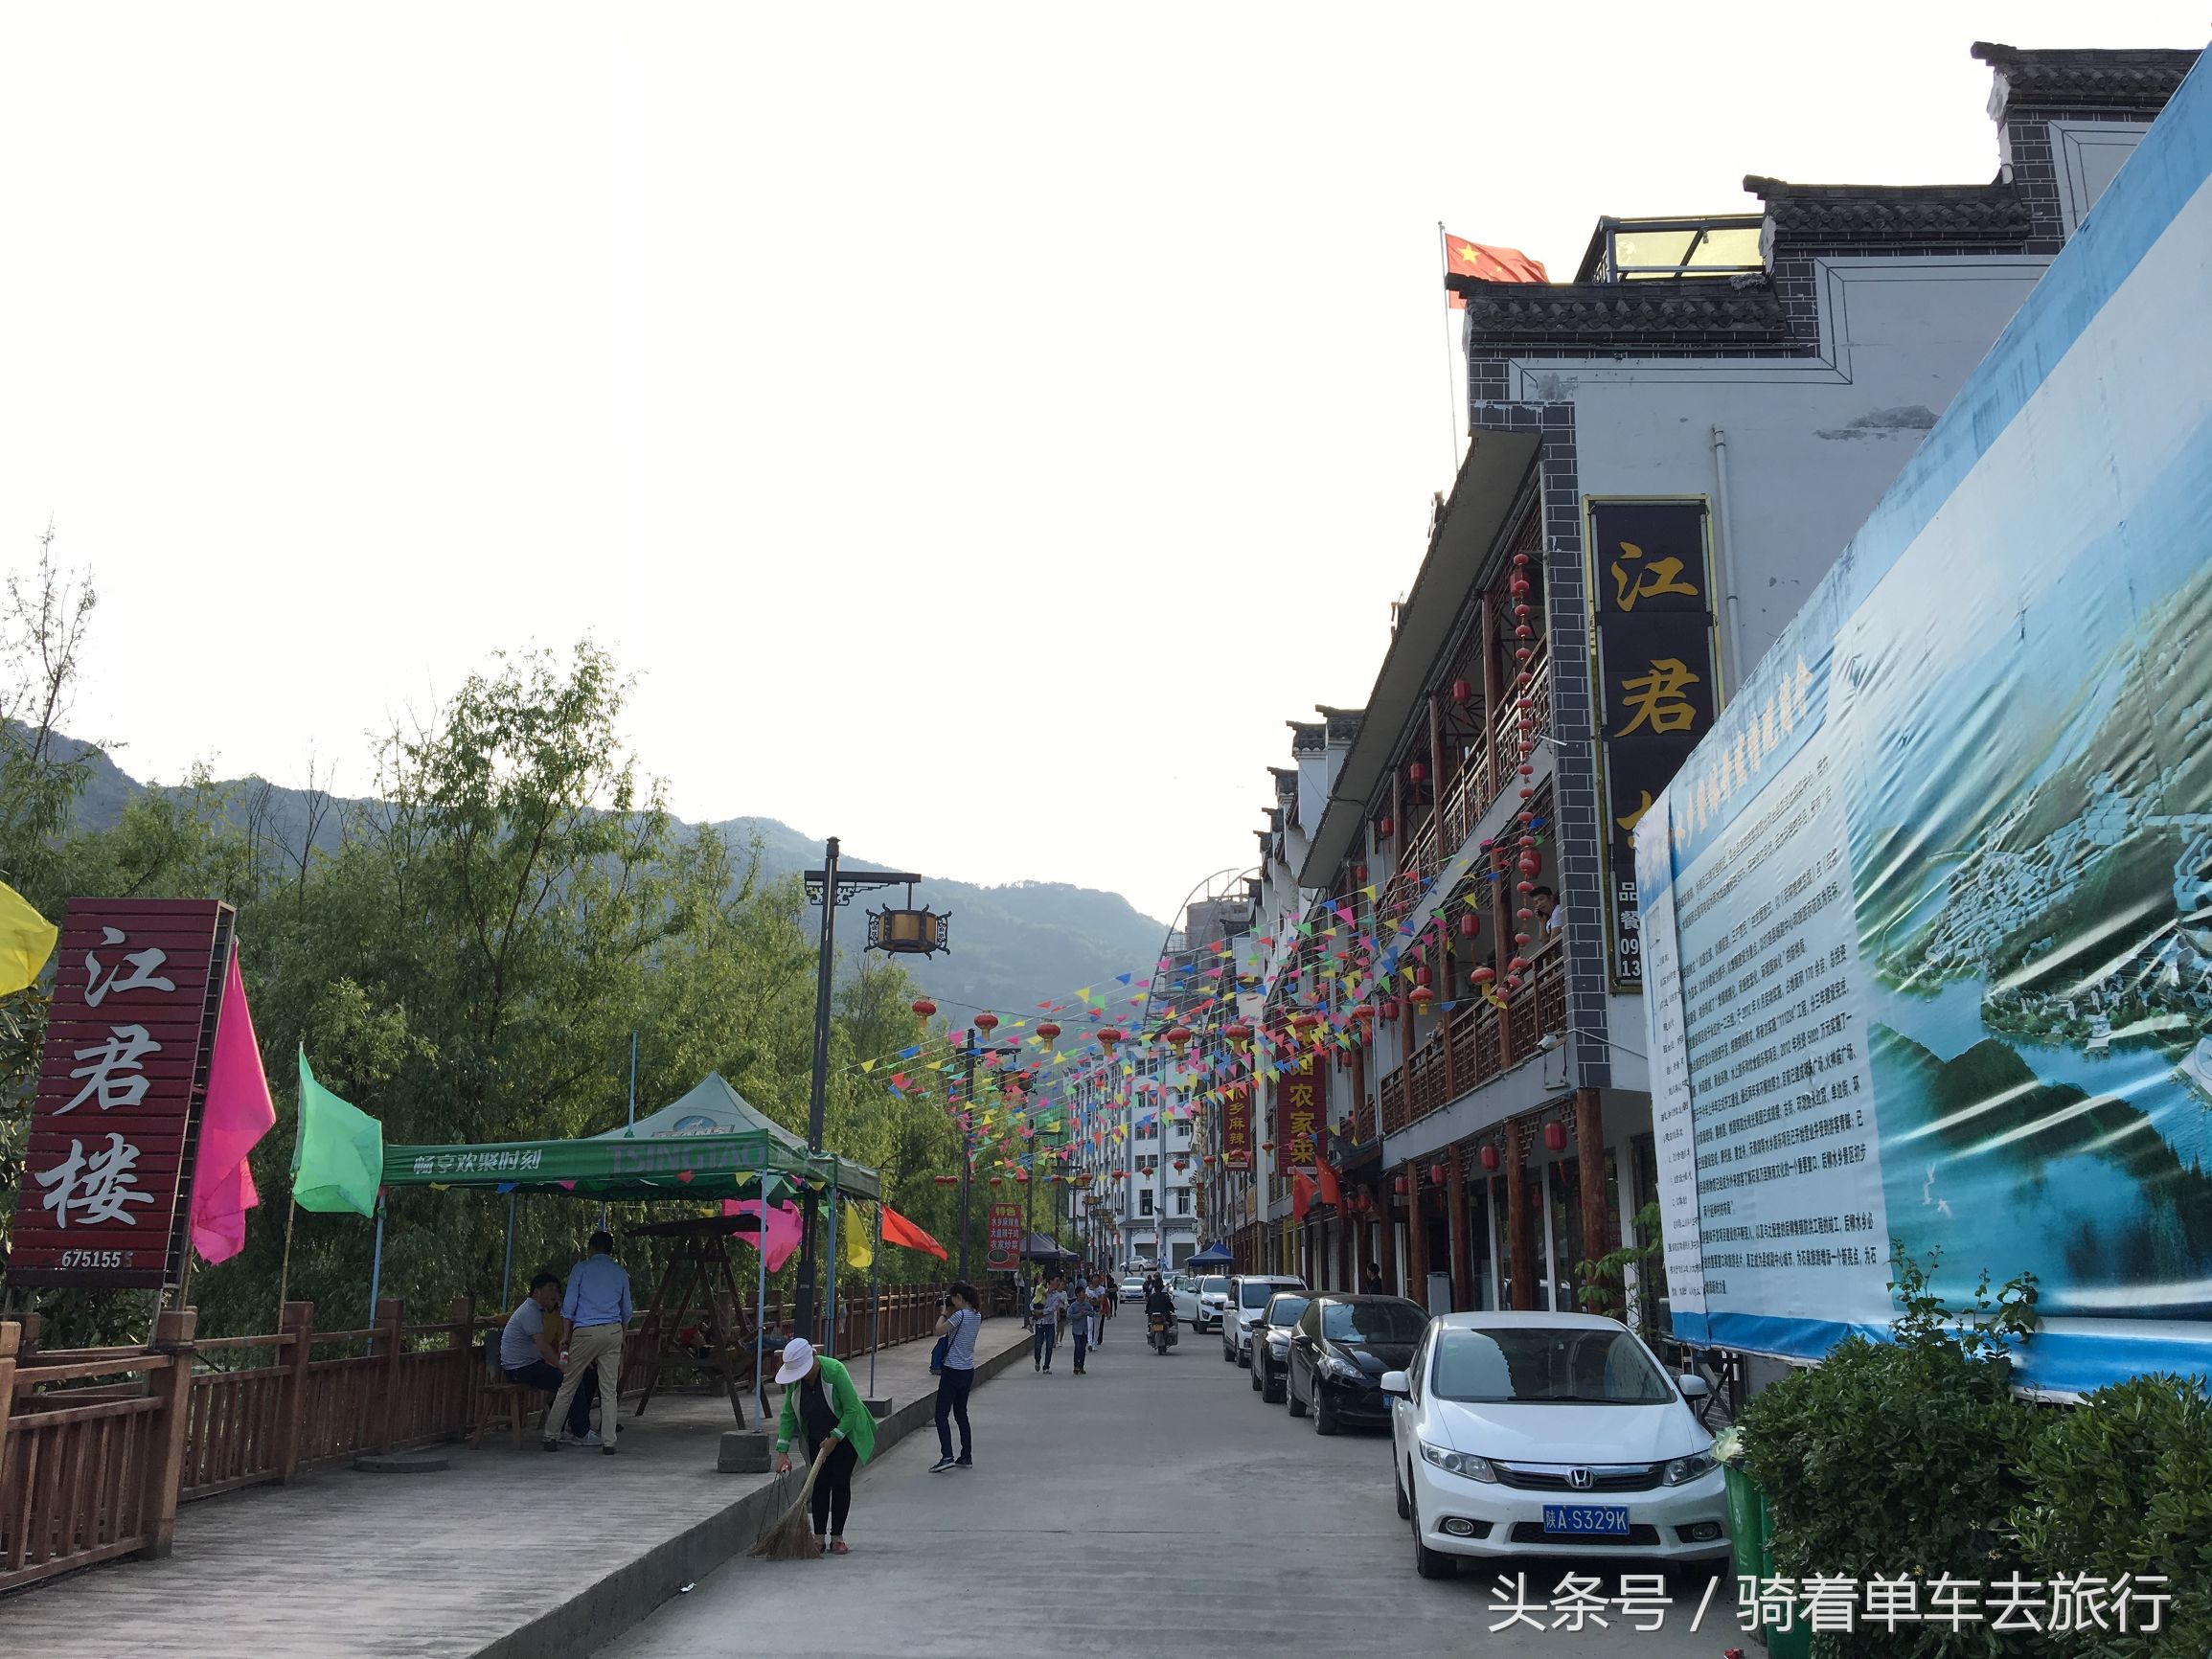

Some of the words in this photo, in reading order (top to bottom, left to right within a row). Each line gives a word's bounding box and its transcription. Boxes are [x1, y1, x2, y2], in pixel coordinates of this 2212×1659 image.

[34, 926, 175, 1229] 江君楼
[413, 1148, 542, 1175] 畅享欢聚时刻
[607, 1141, 766, 1173] TSINGTAO
